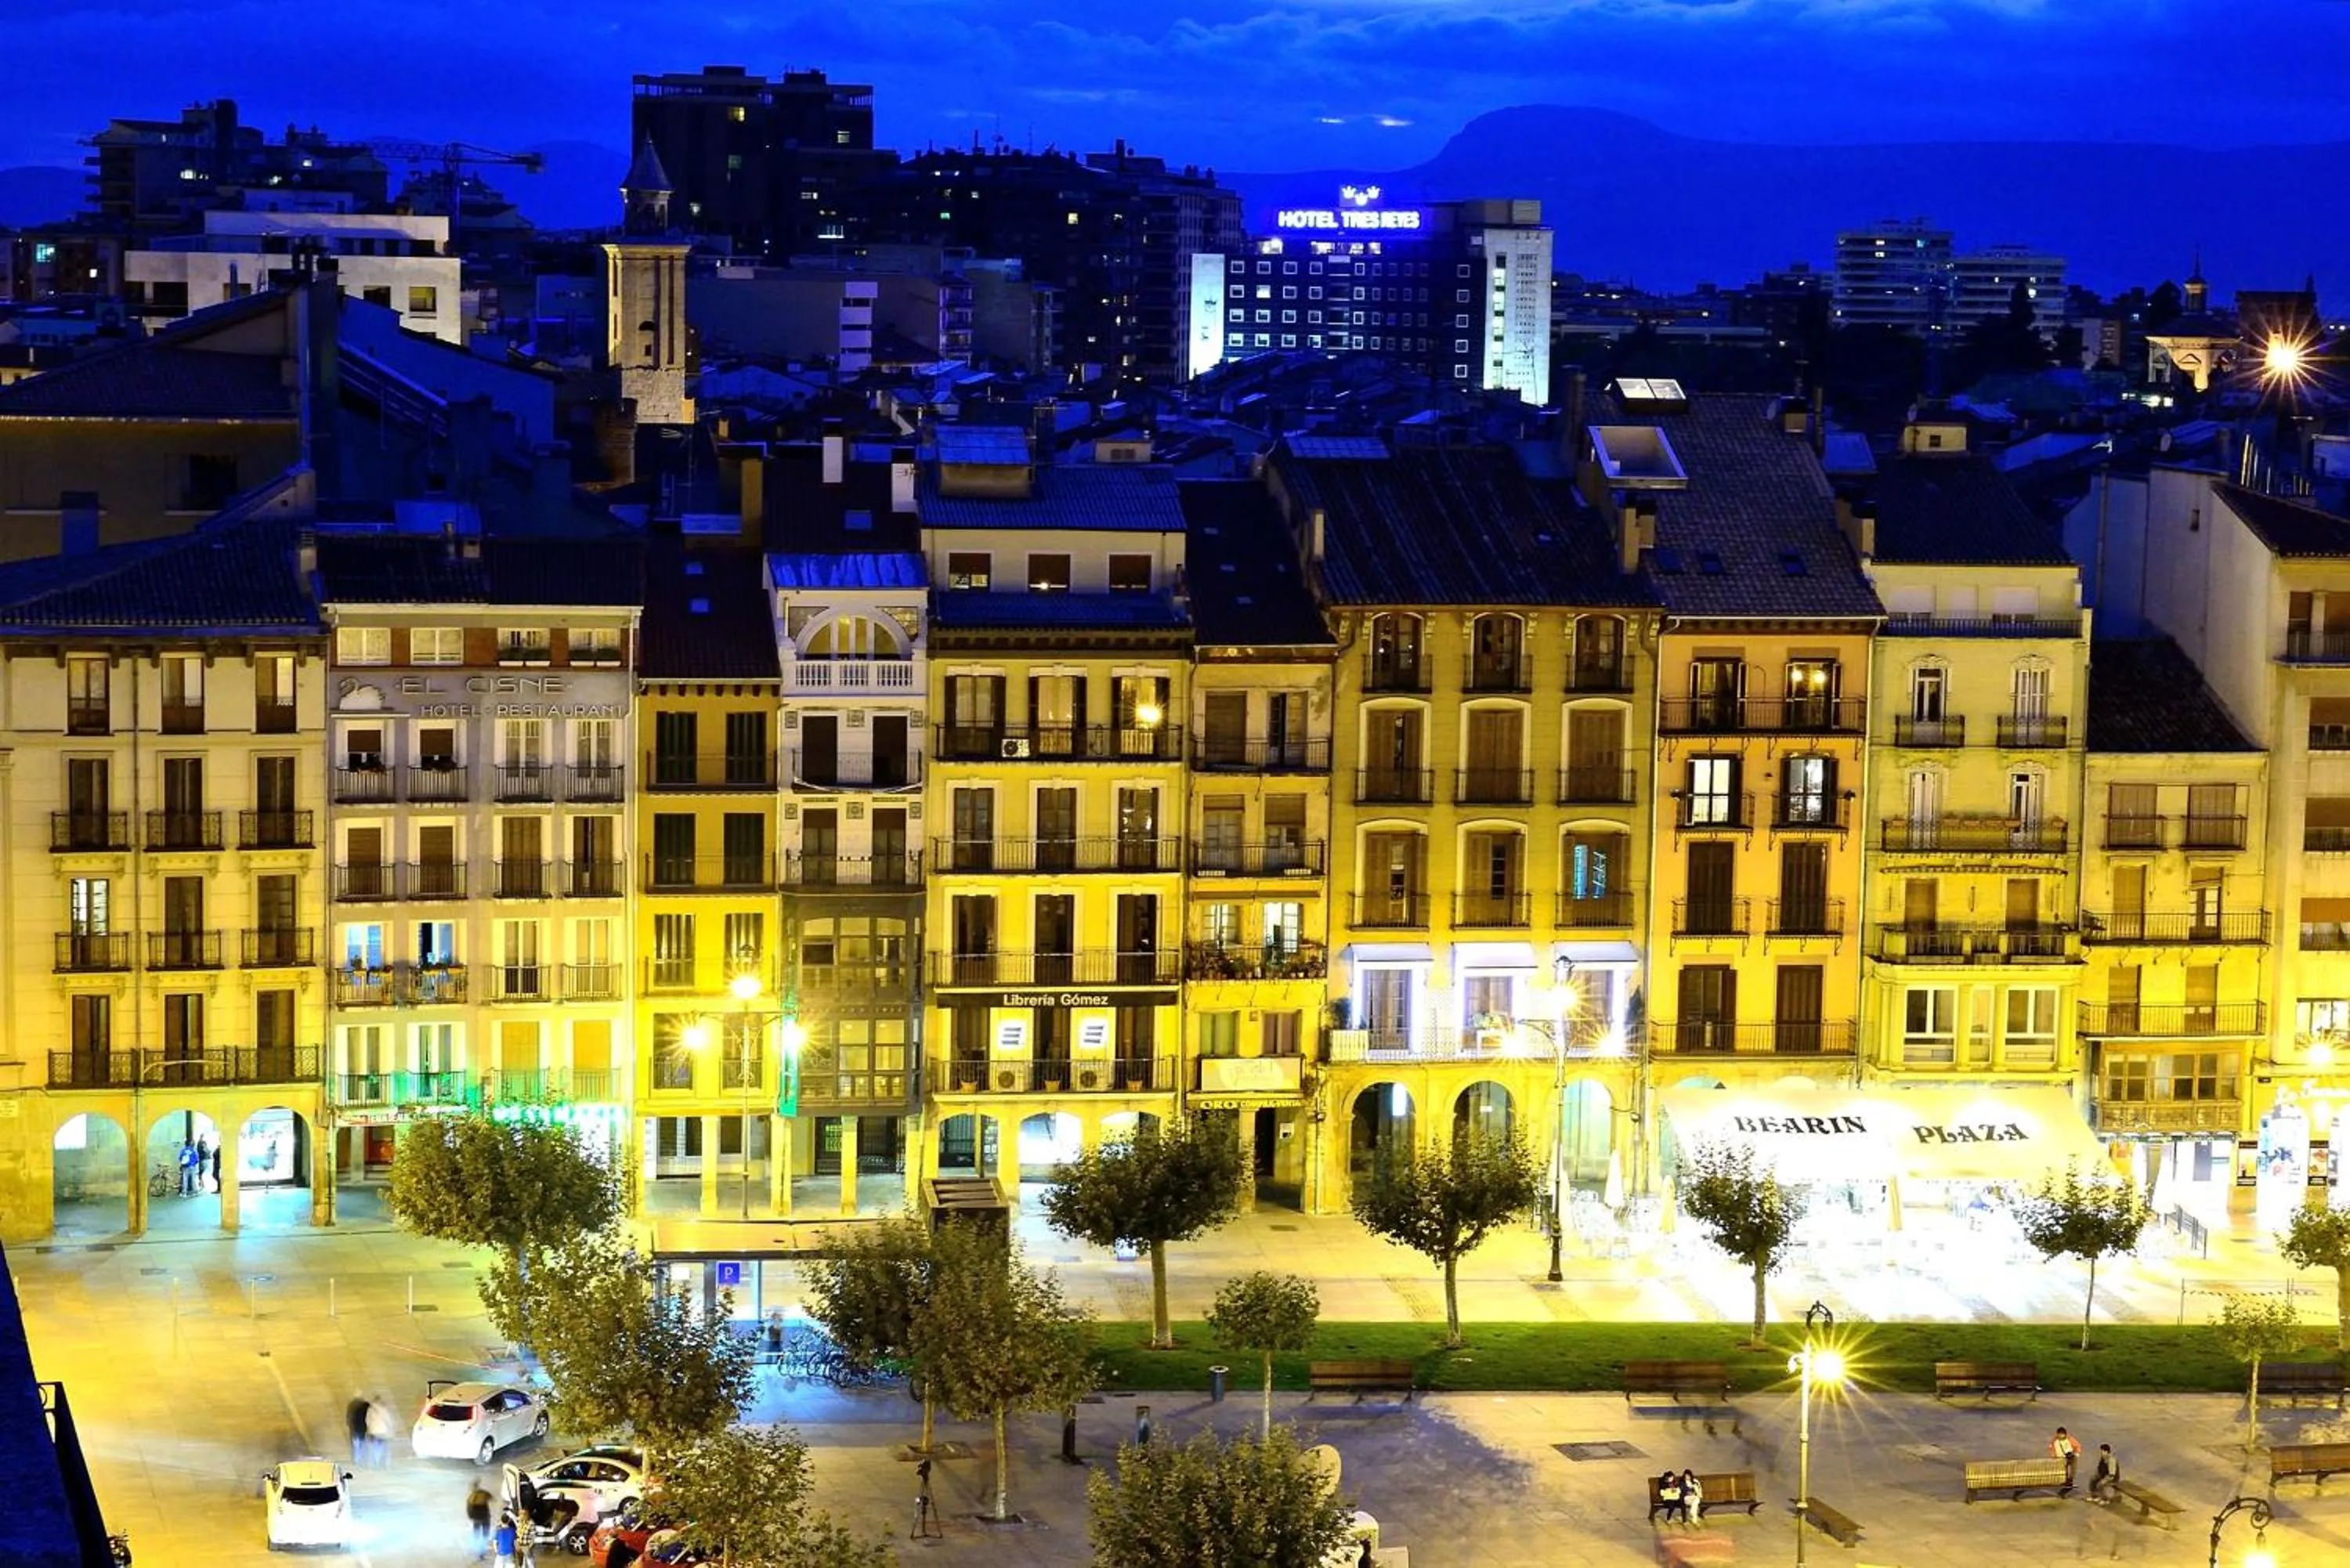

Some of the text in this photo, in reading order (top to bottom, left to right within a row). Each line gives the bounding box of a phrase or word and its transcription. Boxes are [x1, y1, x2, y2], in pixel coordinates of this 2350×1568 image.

[1278, 211, 1420, 229] HOTEL TRES REYES
[402, 677, 565, 695] EL CISNE
[421, 703, 624, 718] HOTEL RESTAURANT
[1003, 993, 1109, 1006] Librería Gómez
[1199, 1100, 1238, 1110] ORO
[1734, 1116, 2030, 1144] BEARIN PLAZA
[725, 1266, 734, 1281] P
